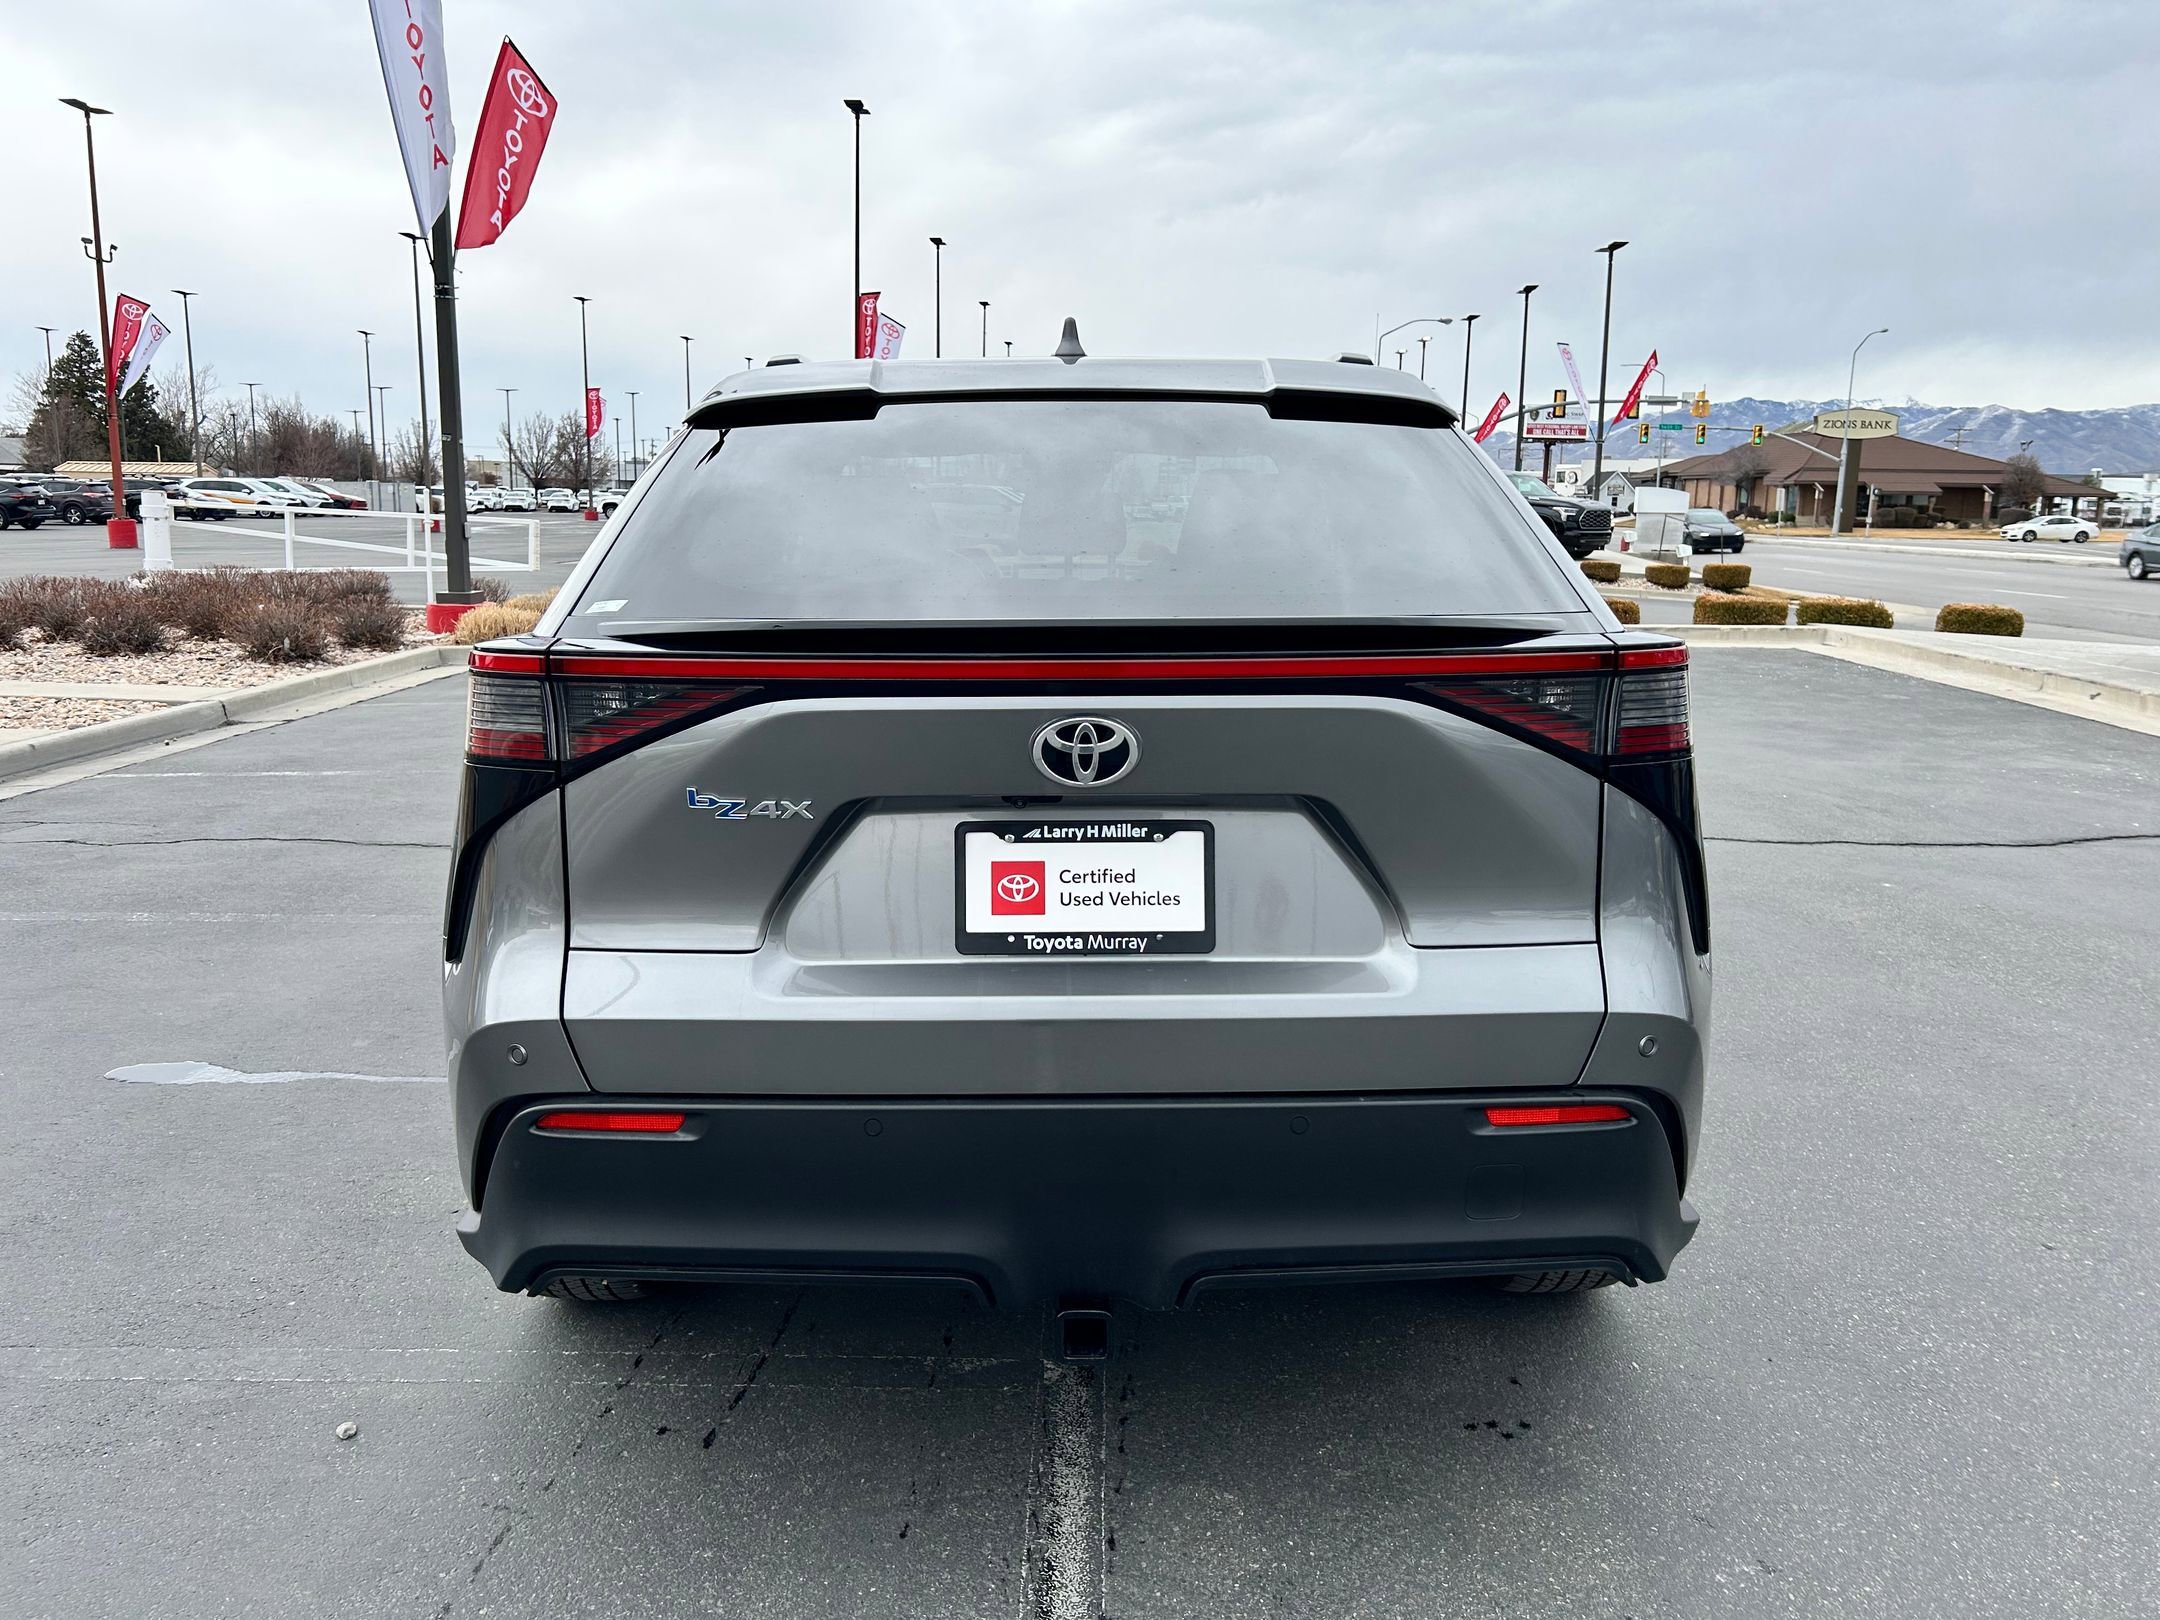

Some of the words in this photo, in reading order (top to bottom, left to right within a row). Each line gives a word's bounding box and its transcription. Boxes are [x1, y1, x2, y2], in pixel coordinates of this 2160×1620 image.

[490, 109, 528, 232] TOYOTA
[864, 318, 872, 359] TOYO
[1823, 420, 1857, 429] ZIONS
[1860, 421, 1893, 430] BANK
[1043, 825, 1084, 841] Larry
[1087, 825, 1099, 838] H
[1101, 824, 1148, 838] Miller
[1059, 868, 1136, 884] Certified
[1060, 892, 1103, 906] Used
[1109, 891, 1181, 906] Vehicles
[1024, 935, 1084, 953] Toyota
[1087, 934, 1148, 953] Murray
